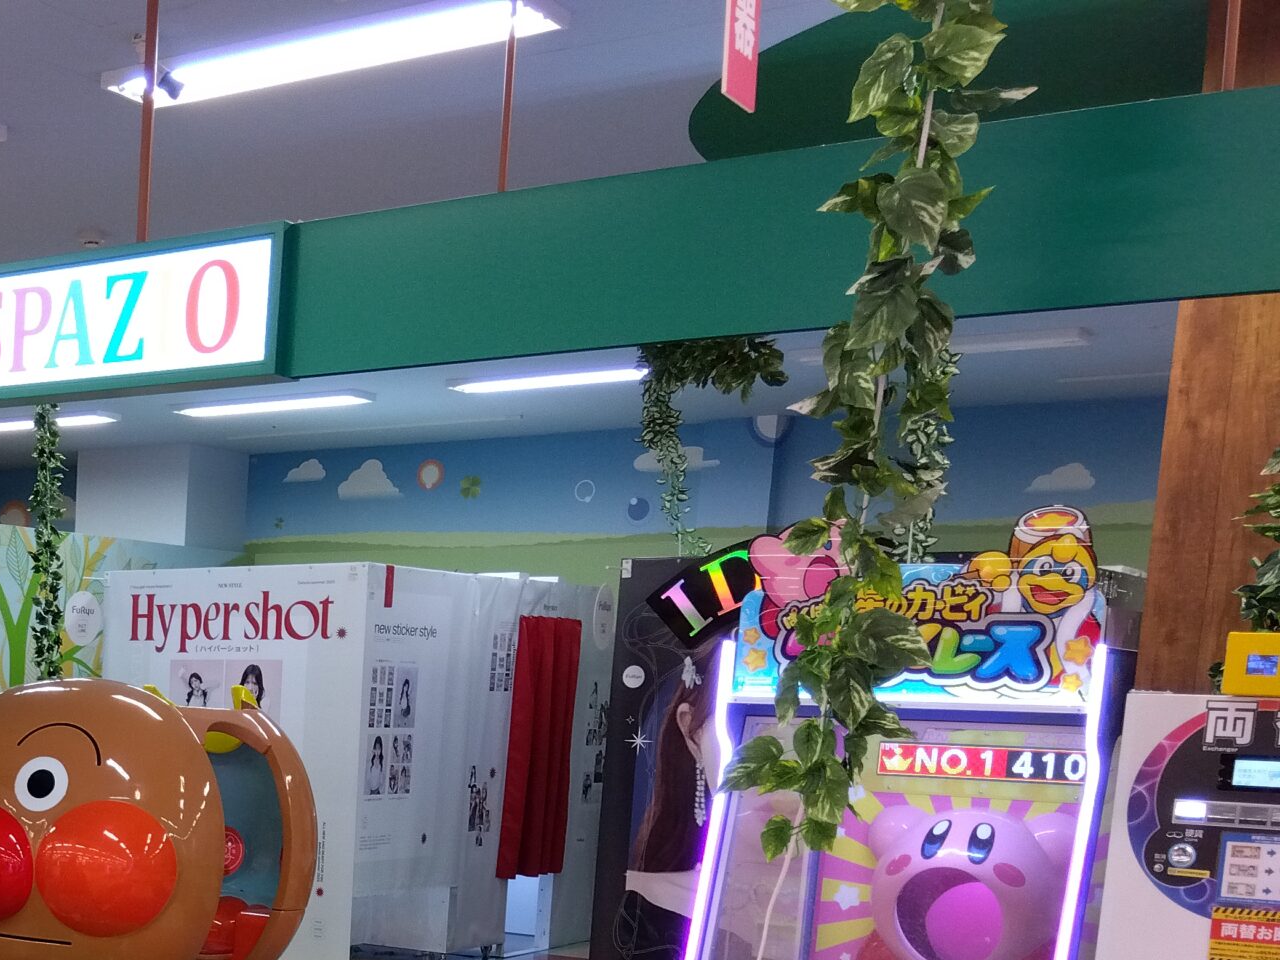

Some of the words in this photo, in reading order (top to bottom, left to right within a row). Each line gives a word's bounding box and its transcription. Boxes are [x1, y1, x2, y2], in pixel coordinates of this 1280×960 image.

[72, 606, 95, 616] FuRyu
[375, 624, 392, 634] new
[392, 624, 418, 636] sticker
[419, 626, 437, 640] style
[914, 747, 992, 776] NO.1
